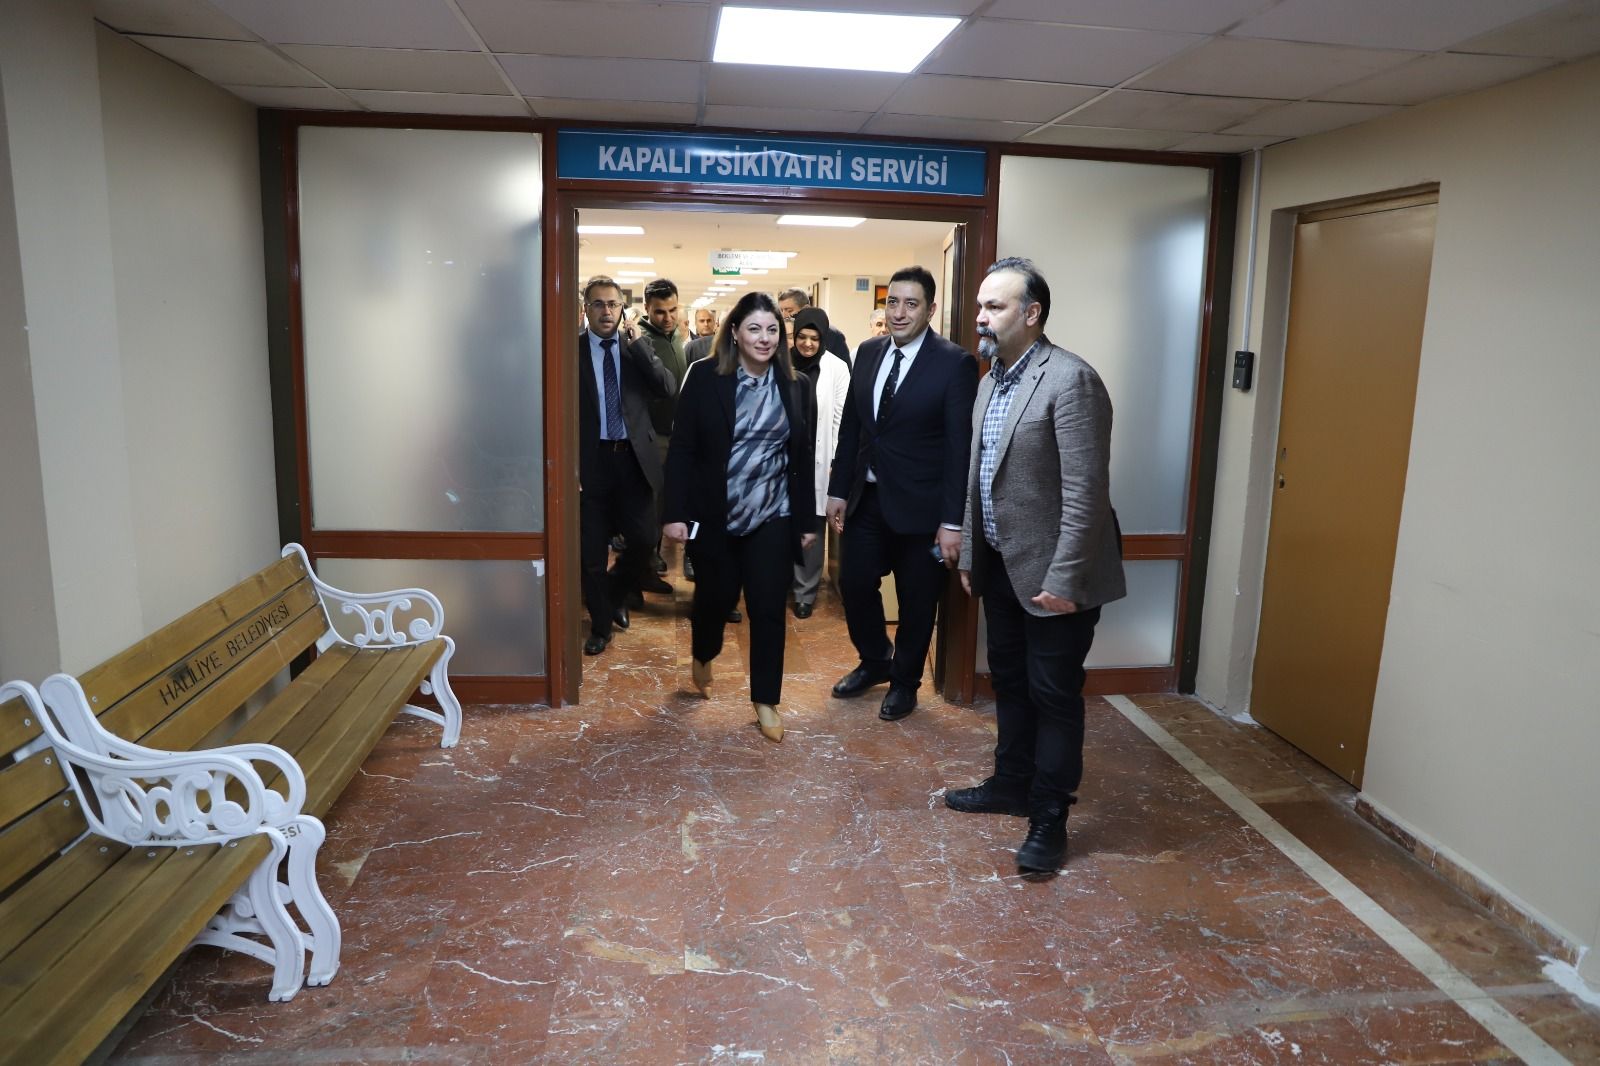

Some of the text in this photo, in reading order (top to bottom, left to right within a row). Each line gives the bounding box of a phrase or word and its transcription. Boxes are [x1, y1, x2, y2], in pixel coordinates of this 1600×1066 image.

[599, 145, 948, 186] KAPALI PSİKİYATRİ SERVİSİ
[225, 600, 290, 657] BELEDİYESİ
